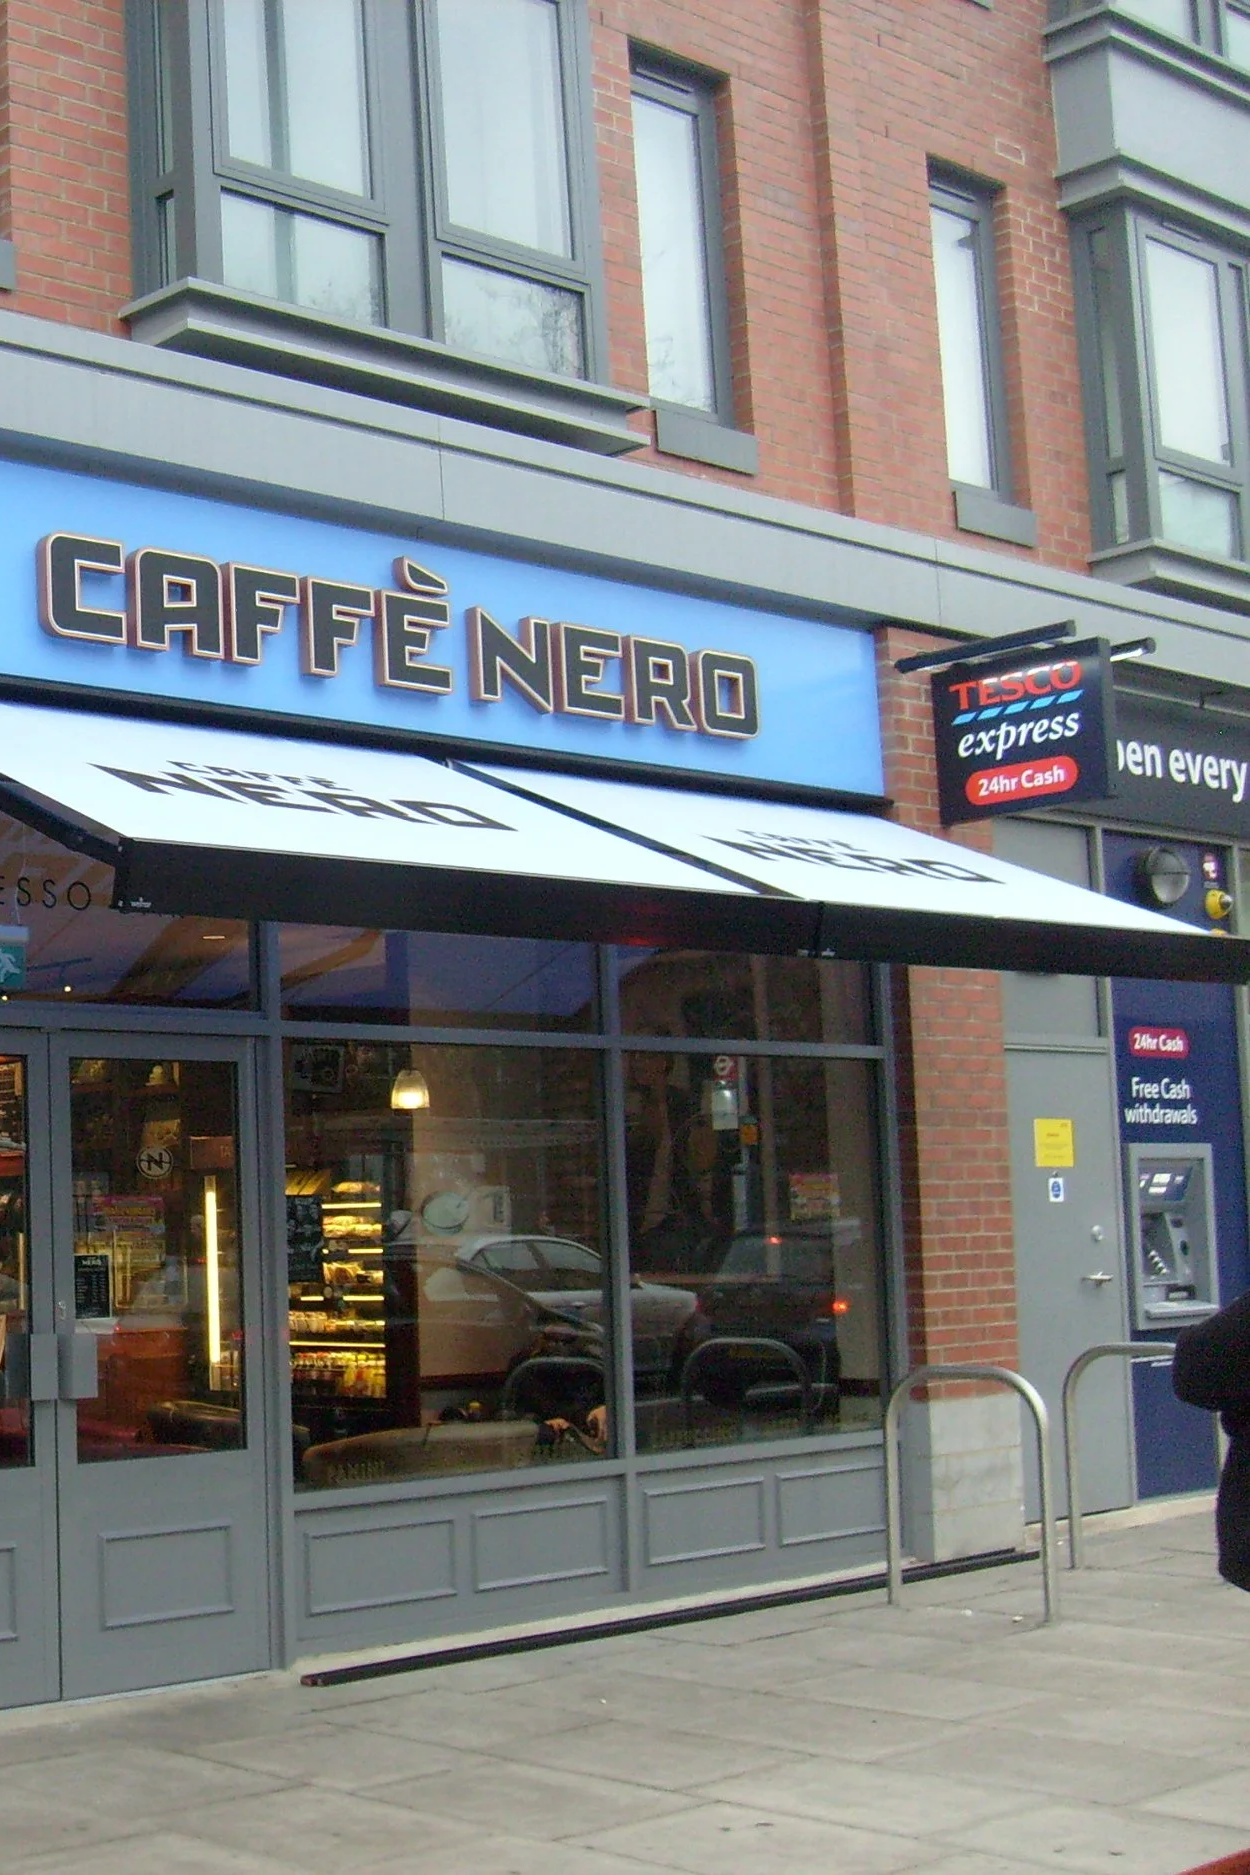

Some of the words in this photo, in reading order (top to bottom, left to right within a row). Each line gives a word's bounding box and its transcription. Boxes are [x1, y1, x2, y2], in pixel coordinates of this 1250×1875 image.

[36, 533, 453, 694] CAFFÈ
[466, 606, 760, 739] NERO
[949, 660, 1083, 710] TESCO
[957, 712, 1081, 760] express
[977, 774, 1018, 797] 24hr
[1021, 765, 1065, 789] Cash
[1116, 740, 1162, 778] en
[1169, 749, 1248, 803] every
[86, 762, 520, 831] NERO
[698, 834, 1007, 884] NERO
[1134, 1033, 1158, 1051] 24hr
[1159, 1034, 1184, 1052] Cash
[1131, 1077, 1160, 1099] Free
[1161, 1078, 1191, 1099] Cash
[1124, 1102, 1198, 1124] withdrawals
